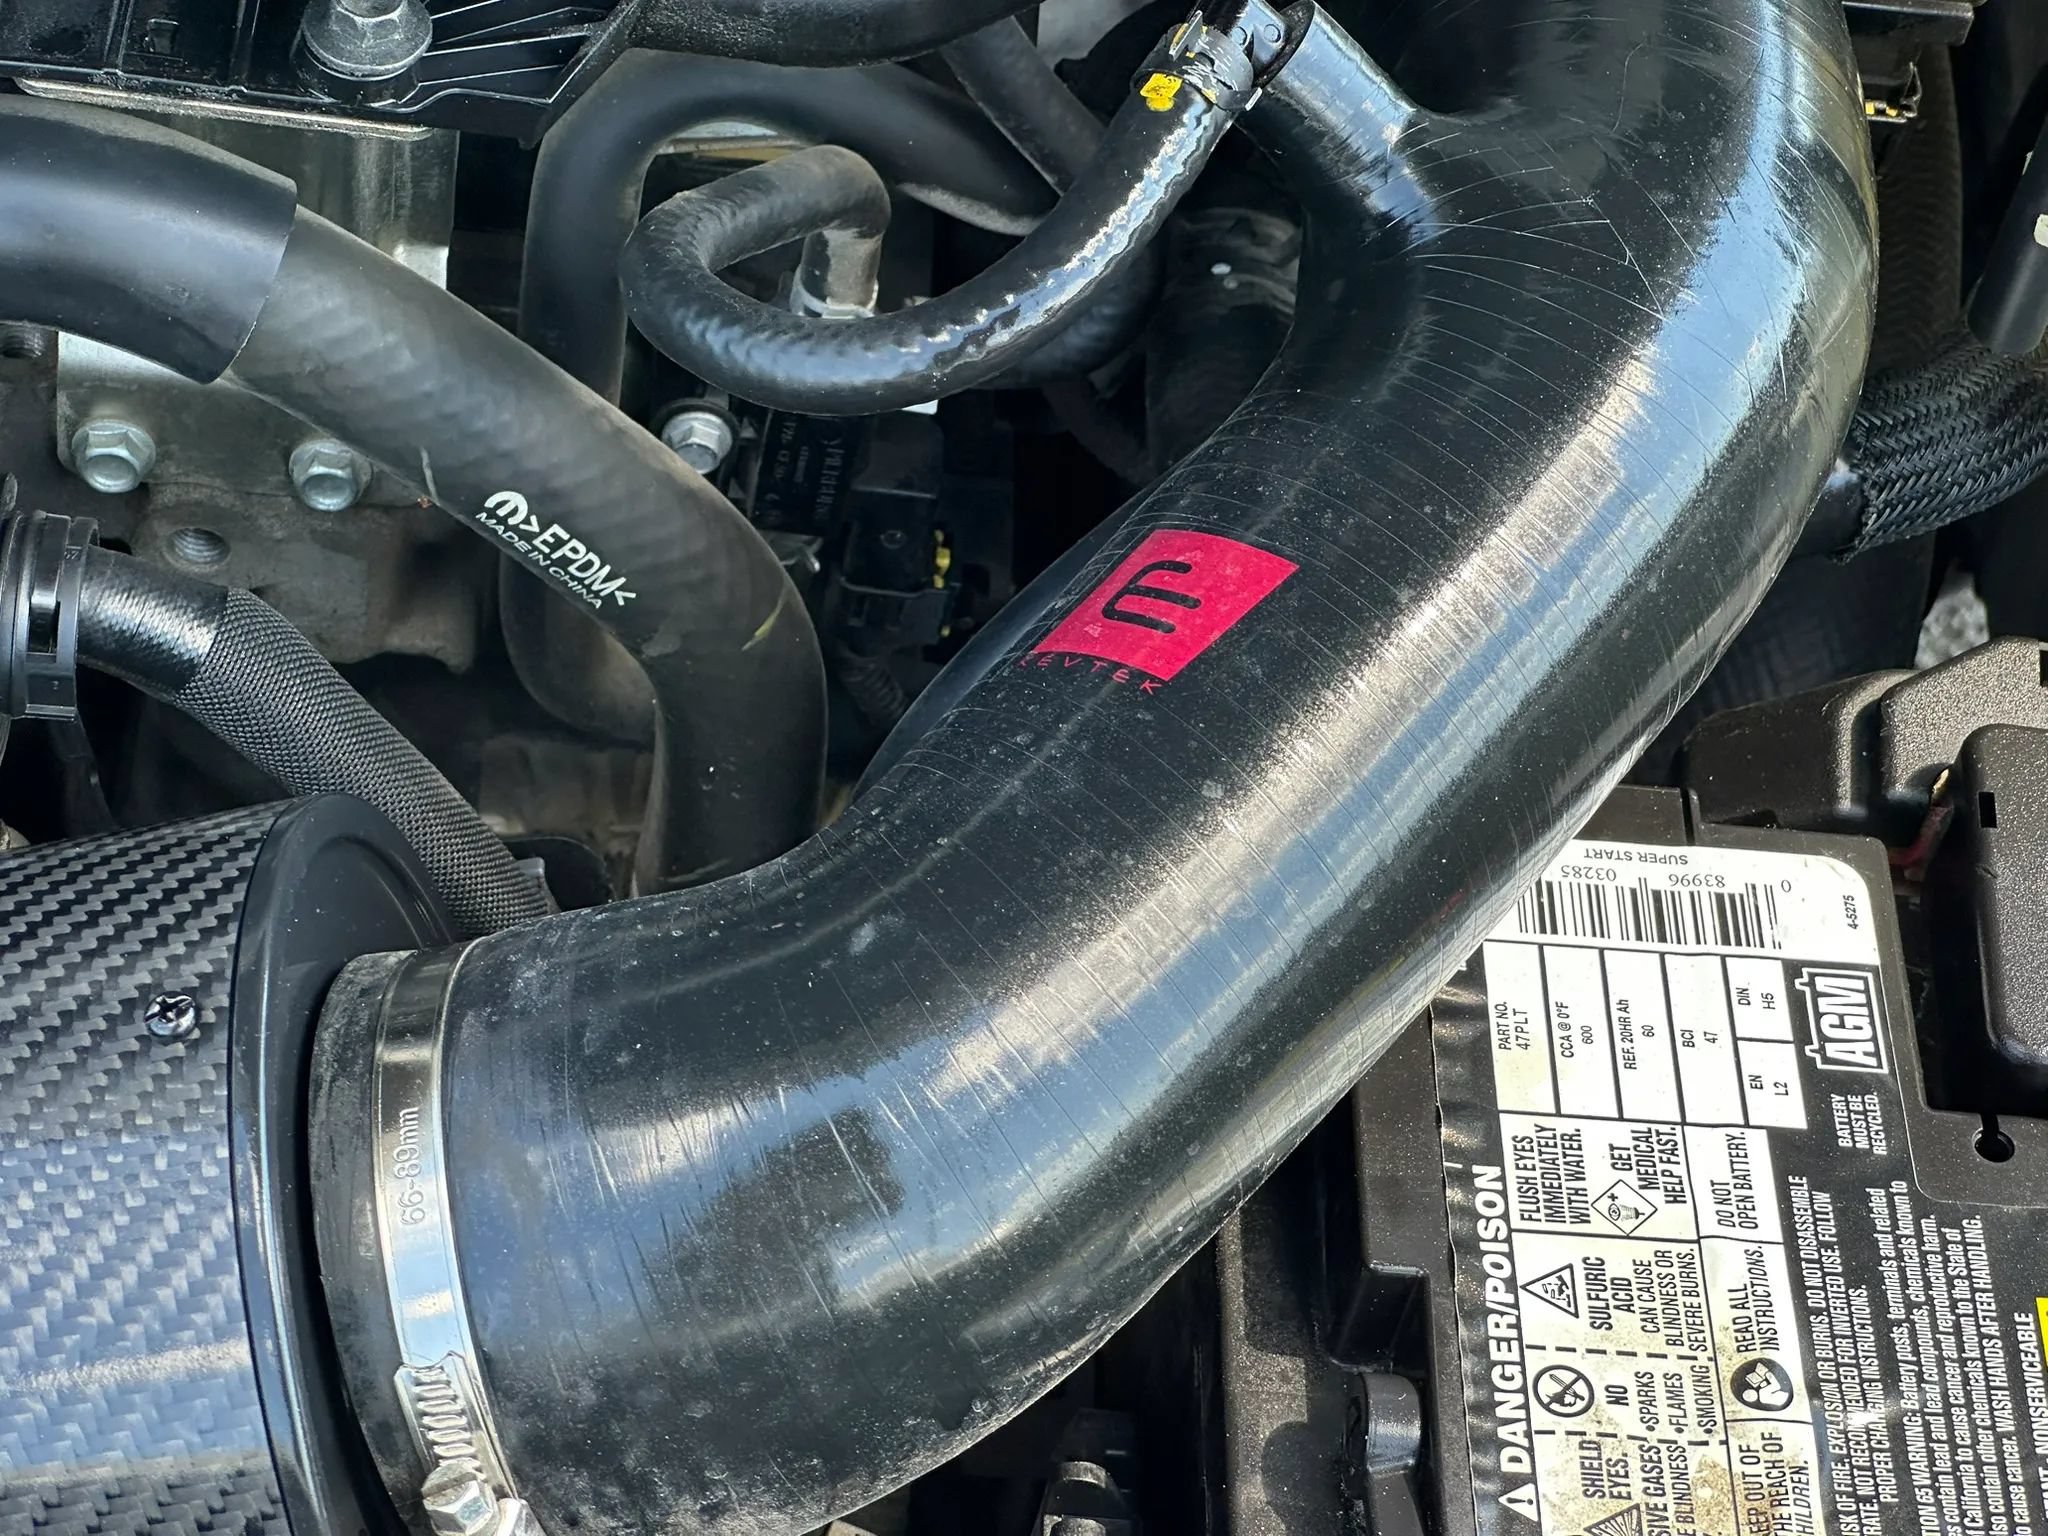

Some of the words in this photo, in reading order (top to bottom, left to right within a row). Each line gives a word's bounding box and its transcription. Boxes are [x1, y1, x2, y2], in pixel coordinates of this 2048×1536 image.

[475, 511, 531, 553] MADE
[528, 551, 552, 567] IN
[548, 566, 603, 610] CHINA
[1561, 865, 1617, 882] 03285
[1584, 848, 1633, 862] START
[1638, 852, 1689, 865] SUPER
[1668, 873, 1726, 889] 83996
[1781, 879, 1791, 893] 0
[1843, 895, 1859, 930] 4-5275
[1495, 1001, 1508, 1018] NO.
[1617, 999, 1630, 1012] Ah
[1735, 987, 1751, 1006] DIN
[1761, 993, 1776, 1010] H5
[1498, 1020, 1512, 1050] PART
[1514, 1008, 1531, 1050] 47PLT
[1558, 1020, 1572, 1032] @
[1581, 1025, 1594, 1045] 600
[1619, 1014, 1634, 1044] 20HR
[1642, 1024, 1654, 1037] 60
[1682, 1030, 1695, 1048] BCI
[1708, 1031, 1718, 1044] 47
[1815, 975, 1878, 1067] AGM
[1560, 1034, 1574, 1058] CCA
[1623, 1046, 1637, 1070] REF.
[1750, 1075, 1762, 1090] EN
[1775, 1081, 1788, 1096] L2
[1830, 1093, 1853, 1147] BATTERY
[1847, 1095, 1864, 1111] BE
[1850, 1112, 1870, 1149] MUST
[1864, 1091, 1887, 1155] RECYCLED.
[1512, 1135, 1536, 1171] EYES
[1560, 1128, 1586, 1181] WATER.
[1608, 1144, 1633, 1171] GET
[1631, 1127, 1660, 1190] MEDICAL
[1655, 1127, 1681, 1166] FAST.
[1728, 1131, 1752, 1189] BATTERY.
[393, 1107, 425, 1226] 66-89mm
[1534, 1124, 1567, 1223] IMMEDIATELY
[1517, 1176, 1542, 1222] FLUSH
[1567, 1185, 1592, 1224] WITH
[1661, 1169, 1687, 1204] HELP
[1710, 1180, 1731, 1205] NOT
[1889, 1180, 1908, 1193] to
[1717, 1208, 1736, 1228] DO
[1735, 1191, 1759, 1229] OPEN
[1788, 1175, 1819, 1259] DISASSEMBLE
[1812, 1190, 1838, 1242] FOLLOW
[1865, 1188, 1891, 1232] related
[1895, 1195, 1915, 1236] known
[1873, 1233, 1896, 1257] and
[1920, 1215, 1941, 1252] harm.
[1941, 1227, 1961, 1241] of
[1962, 1215, 1992, 1289] HANDLING.
[1654, 1250, 1674, 1268] OR
[1676, 1248, 1700, 1298] BURNS.
[1801, 1261, 1823, 1287] NOT
[1820, 1245, 1843, 1273] USE.
[1897, 1237, 1925, 1302] chemicals
[1945, 1244, 1967, 1276] State
[1582, 1256, 1613, 1331] SULFURIC
[1610, 1276, 1636, 1314] ACID
[1633, 1259, 1656, 1302] CAUSE
[1727, 1283, 1750, 1310] ALL
[1744, 1245, 1780, 1351] INSTRUCTIONS.
[1806, 1290, 1826, 1308] DO
[1878, 1259, 1905, 1319] terminals
[1925, 1253, 1956, 1332] reproductive
[1951, 1278, 1971, 1299] the
[1471, 1164, 1534, 1475] DANGER/POISON
[1638, 1306, 1660, 1333] CAN
[1656, 1272, 1685, 1346] BLINDNESS
[1825, 1275, 1852, 1335] INVERTED
[1955, 1301, 1974, 1314] to
[1975, 1292, 2000, 1336] AFTER
[1683, 1301, 1708, 1352] SEVERE
[1732, 1316, 1757, 1353] READ
[1809, 1311, 1834, 1358] BURNS.
[1848, 1284, 1880, 1379] INSTRUCTIONS.
[1890, 1322, 1917, 1361] posts,
[1910, 1305, 1939, 1382] compounds,
[1960, 1317, 1981, 1358] known
[1835, 1338, 1856, 1363] FOR
[1936, 1334, 1958, 1360] and
[1982, 1339, 2008, 1387] HANDS
[1817, 1361, 1837, 1380] OR
[1898, 1362, 1919, 1410] Battery
[1944, 1360, 1965, 1404] cancer
[2014, 1312, 2048, 1454] NONSERVICEABLE
[1605, 1384, 1630, 1406] NO
[1921, 1383, 1943, 1413] lead
[1963, 1360, 1992, 1426] chemicals
[1991, 1390, 2015, 1432] WASH
[1819, 1382, 1847, 1454] EXPLOSION
[1925, 1415, 1948, 1440] and
[1950, 1406, 1971, 1445] cause
[1738, 1444, 1760, 1465] OF
[1761, 1432, 1783, 1453] OF
[1903, 1412, 1931, 1486] WARNING:
[1929, 1443, 1952, 1472] lead
[1954, 1448, 1974, 1461] to
[1976, 1428, 1997, 1462] other
[2002, 1435, 2023, 1482] cancer.
[1578, 1440, 1606, 1499] SHIELD
[1605, 1452, 1632, 1500] EYES.
[1638, 1444, 1667, 1497] GASES
[1666, 1445, 1696, 1524] BLINDNESS
[1741, 1471, 1766, 1501] OUT
[1765, 1460, 1790, 1508] REACH
[1853, 1468, 1876, 1495] NOT
[1872, 1452, 1899, 1502] PROPER
[1788, 1460, 1814, 1536] HILDREN.
[1835, 1494, 1857, 1511] OF
[1914, 1487, 1935, 1504] 65
[1935, 1475, 1960, 1523] contain
[1956, 1464, 1984, 1527] California
[1980, 1466, 2006, 1513] contain
[2009, 1485, 2030, 1523] cause
[1859, 1499, 1882, 1536] RATE.
